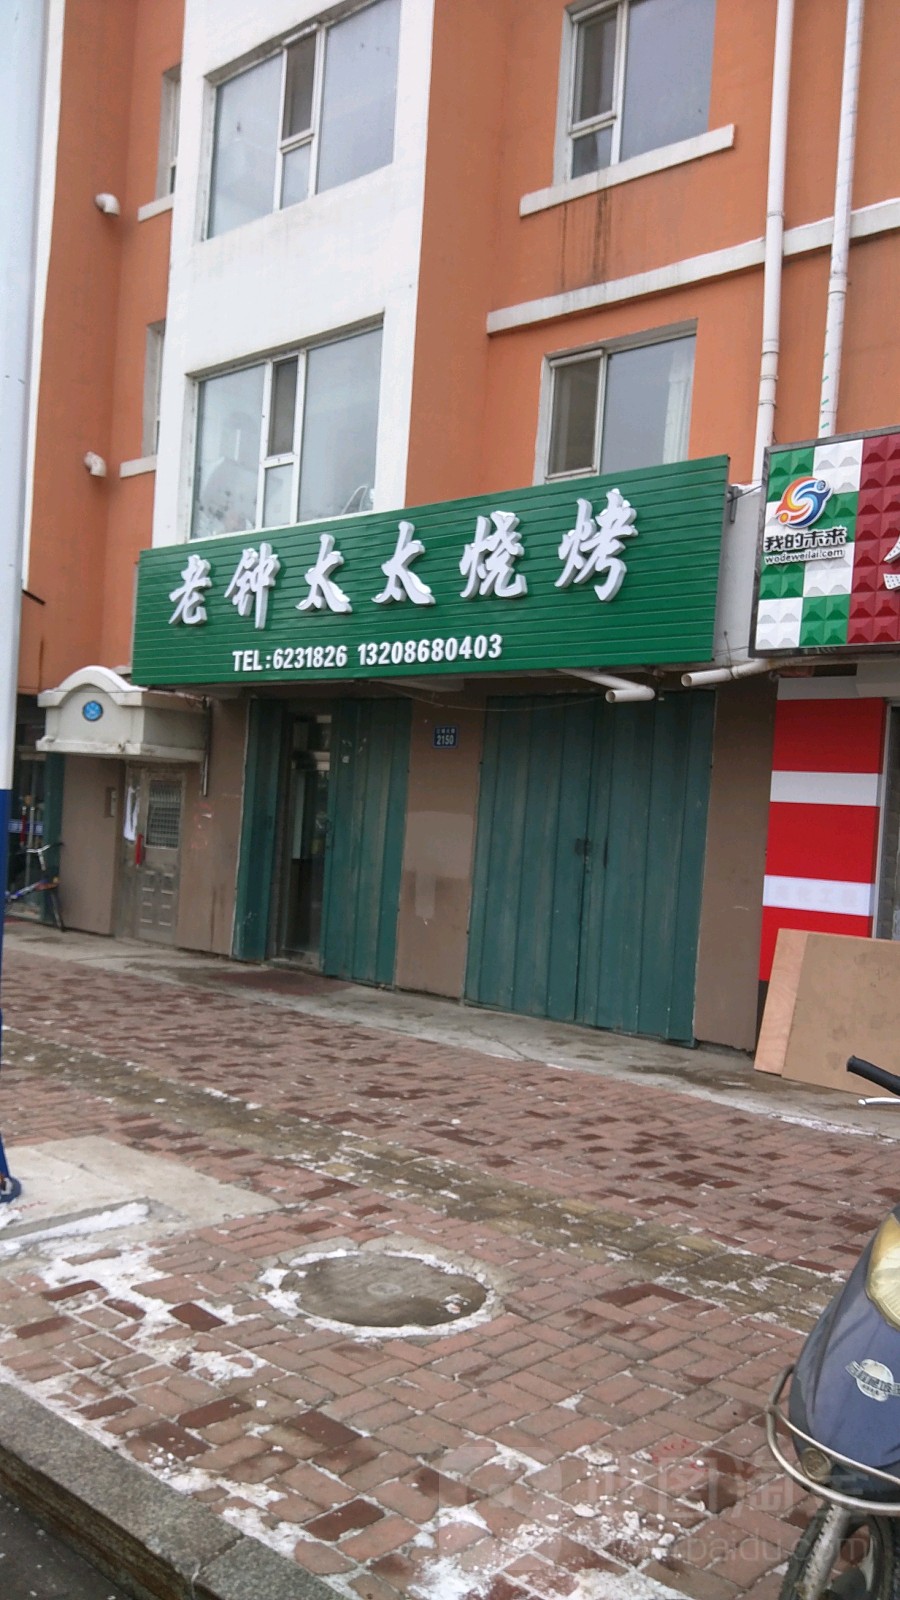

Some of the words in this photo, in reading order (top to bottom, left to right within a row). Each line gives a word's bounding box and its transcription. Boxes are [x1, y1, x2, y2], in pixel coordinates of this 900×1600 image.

[765, 527, 846, 552] 我的未来
[168, 488, 639, 630] 老钟太太烧烤
[232, 645, 348, 672] TEL:6231826
[358, 633, 503, 666] 13208680403
[436, 734, 454, 745] 2150
